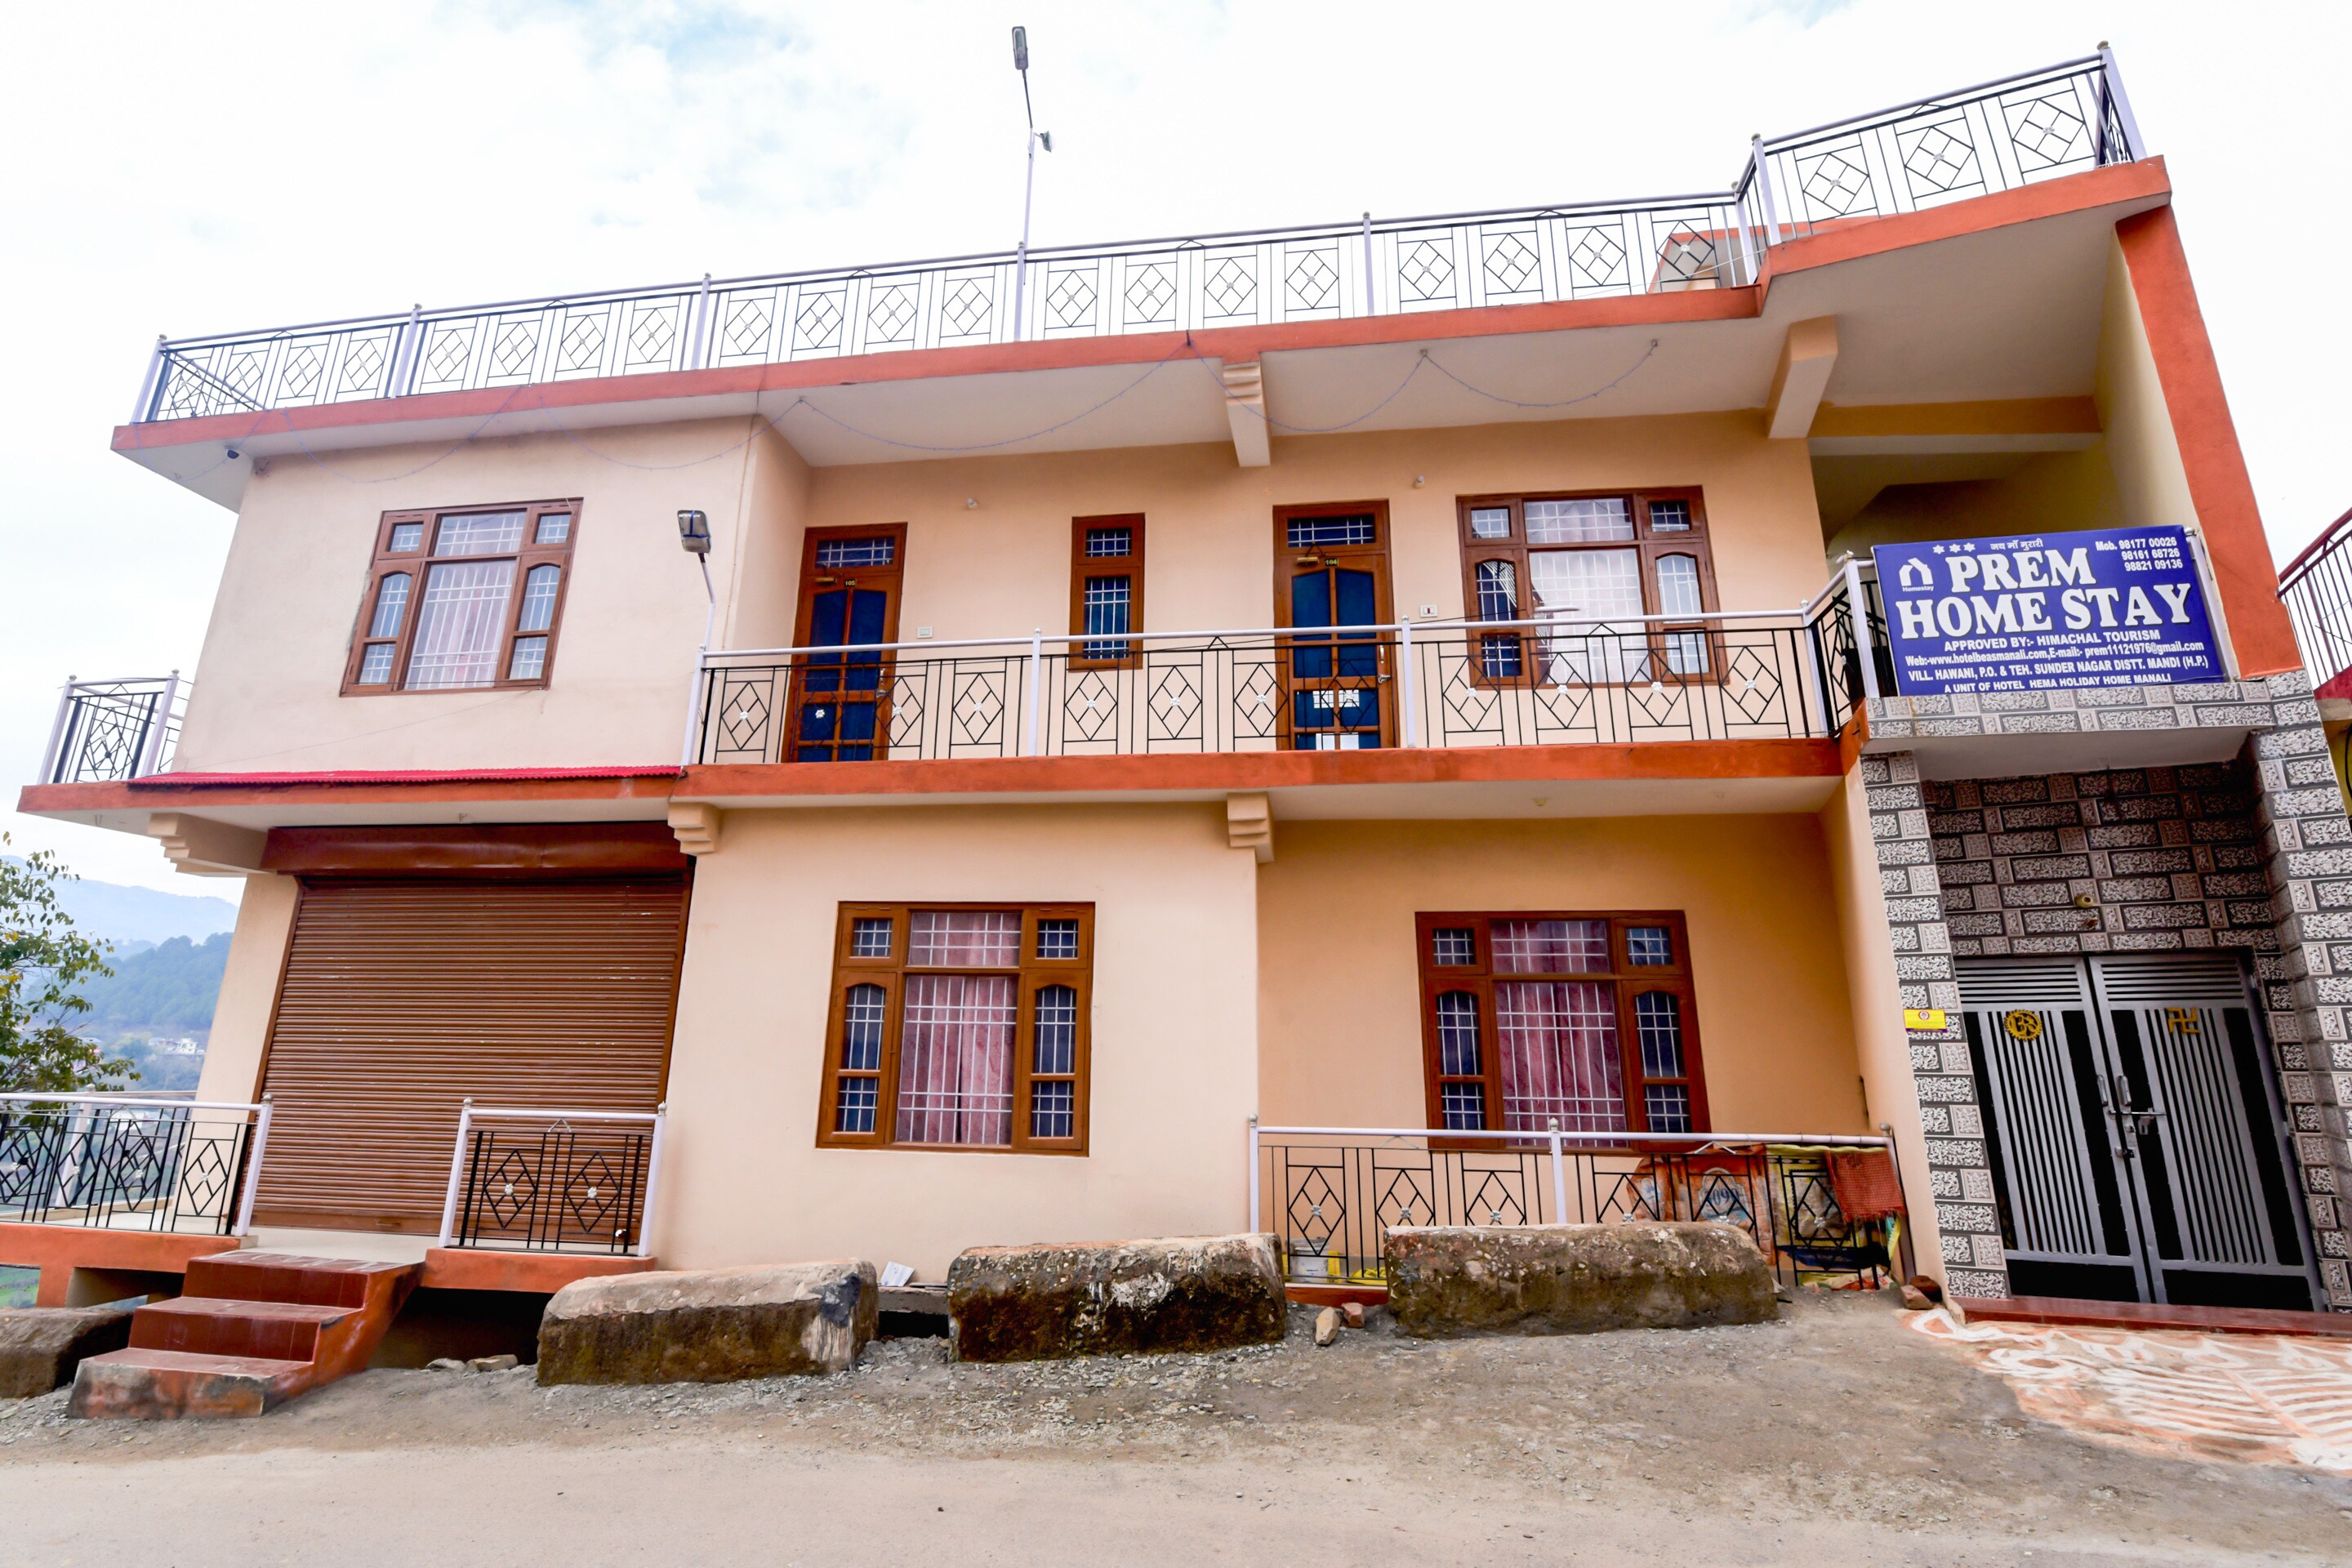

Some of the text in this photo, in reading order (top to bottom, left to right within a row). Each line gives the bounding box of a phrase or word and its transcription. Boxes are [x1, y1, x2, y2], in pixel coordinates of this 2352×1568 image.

[2096, 537, 2176, 551] Mob. 98177 00026
[2122, 548, 2180, 560] 98161 68726
[1945, 548, 2096, 593] PREM
[2125, 559, 2182, 572] 98821 09136
[1895, 583, 2191, 639] HOME STAY
[1944, 638, 2007, 652] APPROVED
[2037, 633, 2101, 646] HIMACHAL
[2103, 630, 2161, 642] TOURISM
[2084, 641, 2204, 659] prem11121976@gmail.com
[1908, 655, 2208, 681] VILL. HAWANI, P.O. & TEH. SUNDER NAGAR DISTT. MANDI (H.P.)
[1944, 674, 2172, 693] A UNIT OF HOTEL HEMA HOLIDAY HOME MANALI
